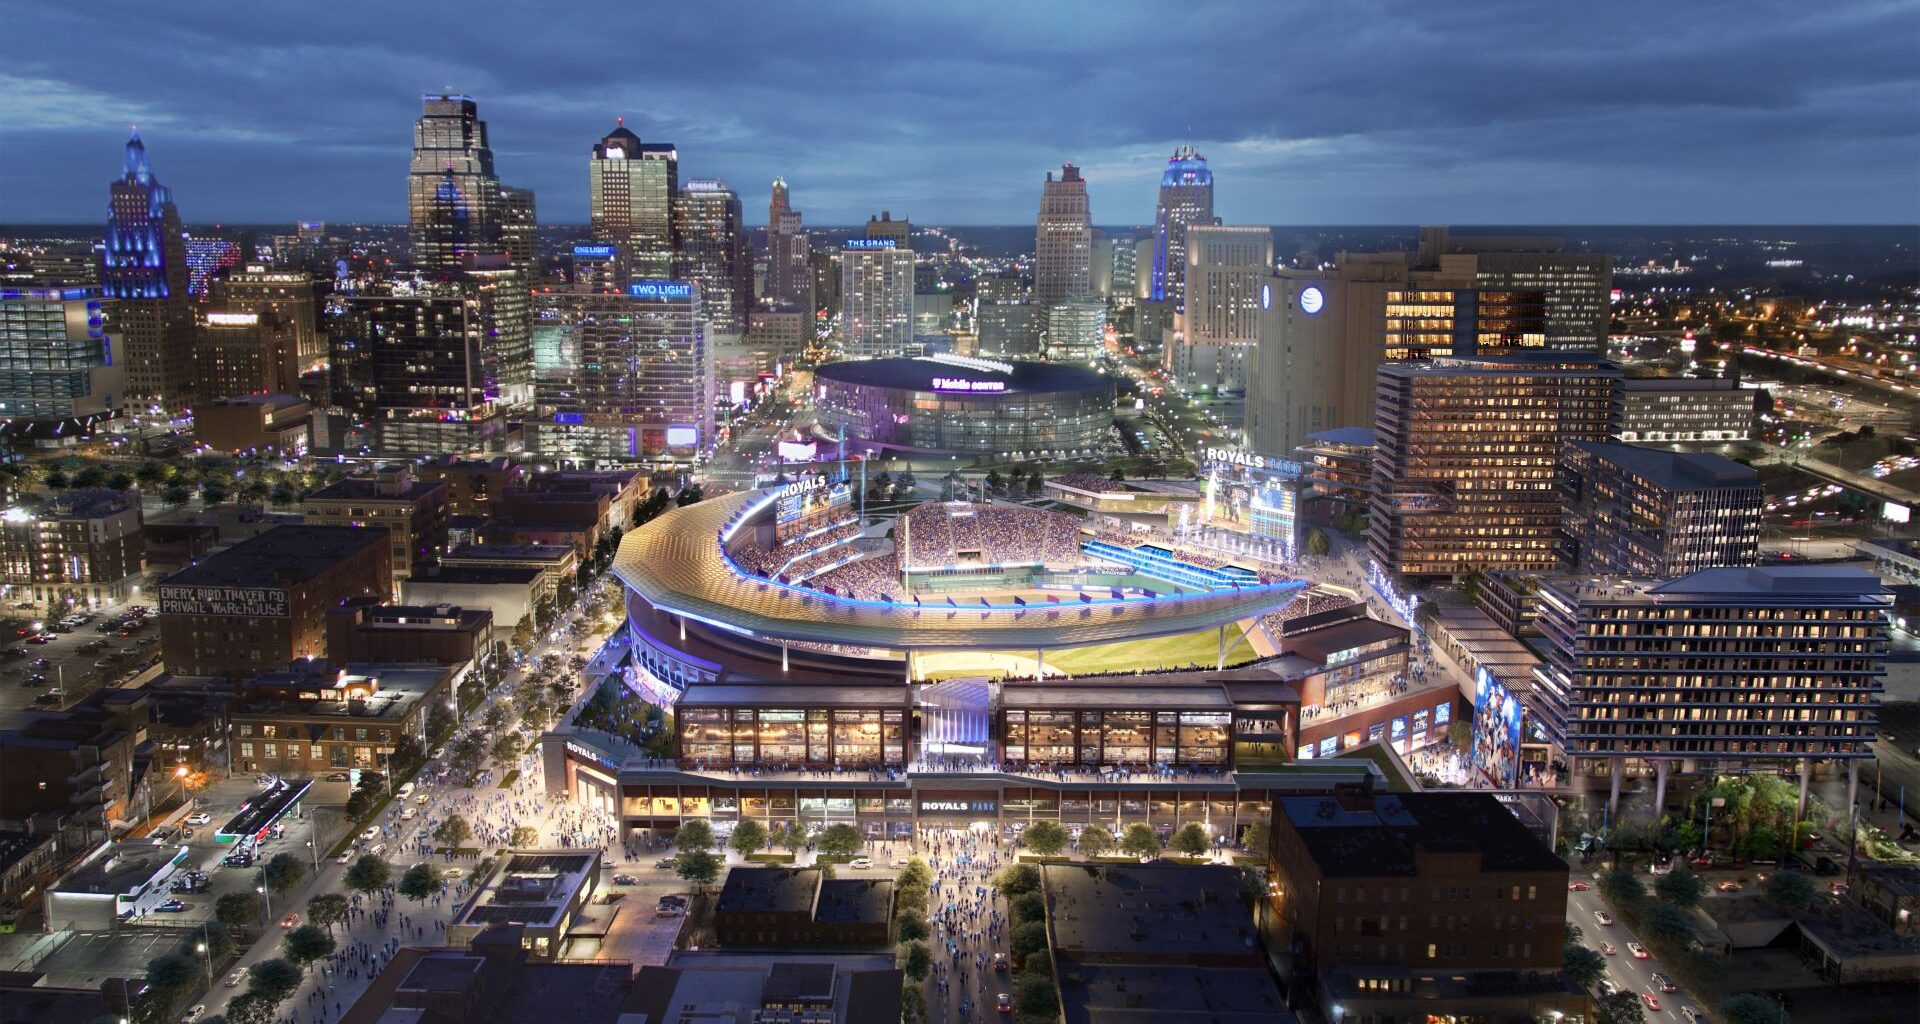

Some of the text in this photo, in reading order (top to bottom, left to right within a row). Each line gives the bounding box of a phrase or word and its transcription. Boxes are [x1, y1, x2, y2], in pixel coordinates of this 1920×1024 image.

[632, 285, 689, 295] TWO LIGHT
[1207, 447, 1300, 475] ROYALS PARK
[781, 475, 826, 498] ROYALS
[160, 587, 193, 599] EMERY
[224, 589, 265, 602] THAYER
[163, 600, 206, 613] PRIVATE
[567, 741, 597, 761] ROYALS
[922, 802, 994, 811] ROYALS PARK
